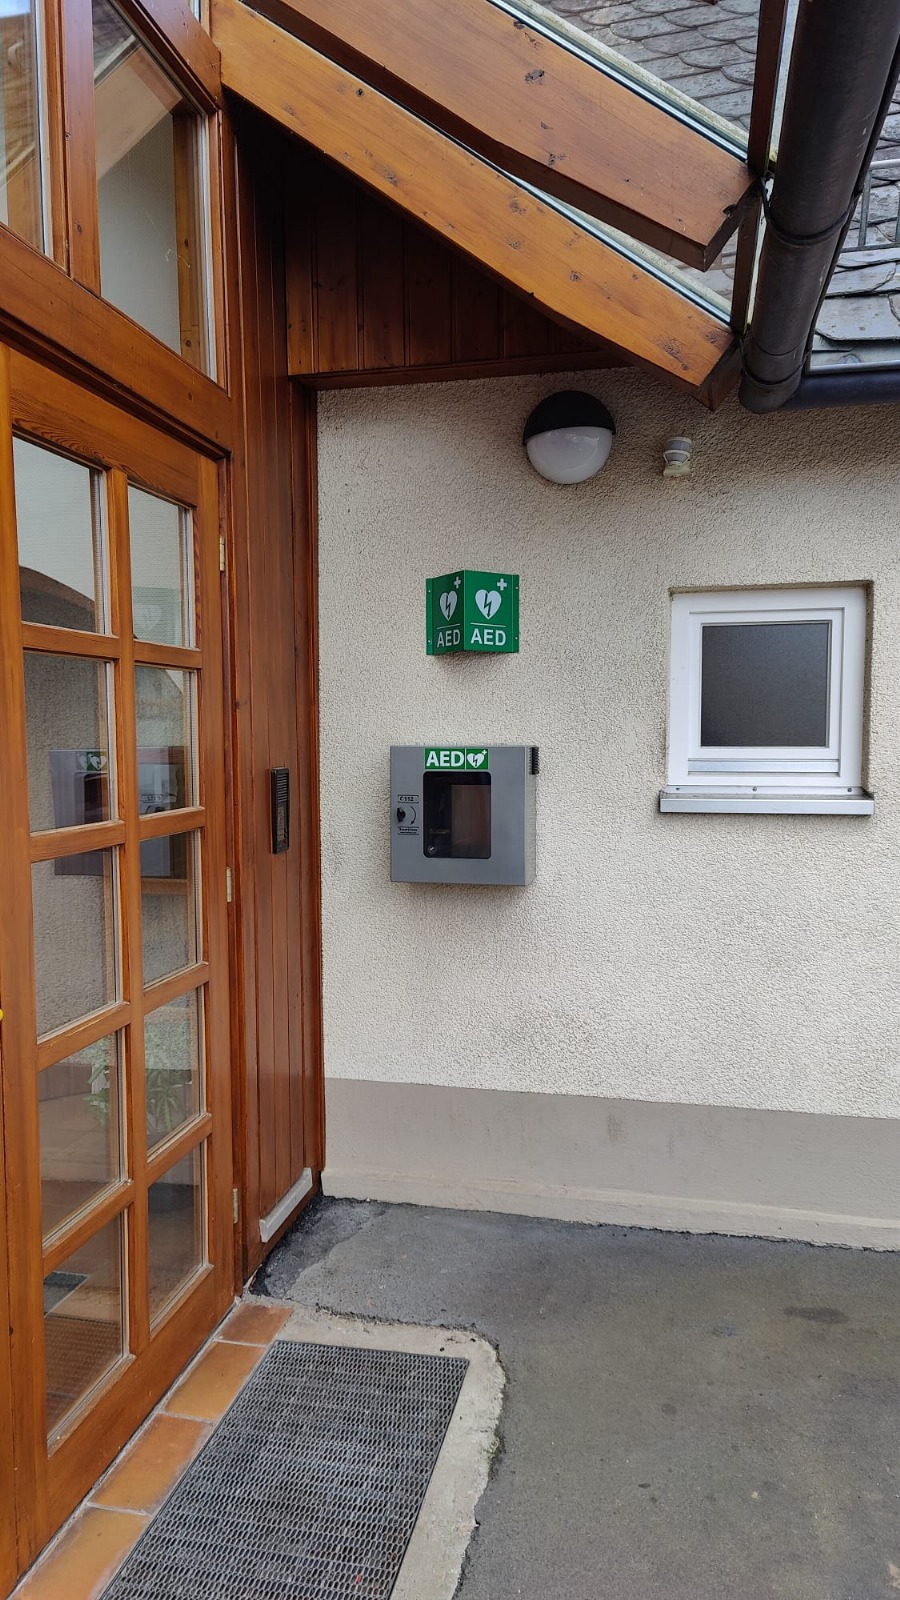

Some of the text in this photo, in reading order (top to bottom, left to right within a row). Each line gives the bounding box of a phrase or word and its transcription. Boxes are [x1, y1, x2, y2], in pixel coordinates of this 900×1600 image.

[436, 629, 461, 648] AED
[470, 628, 506, 646] AED
[426, 750, 465, 767] AED
